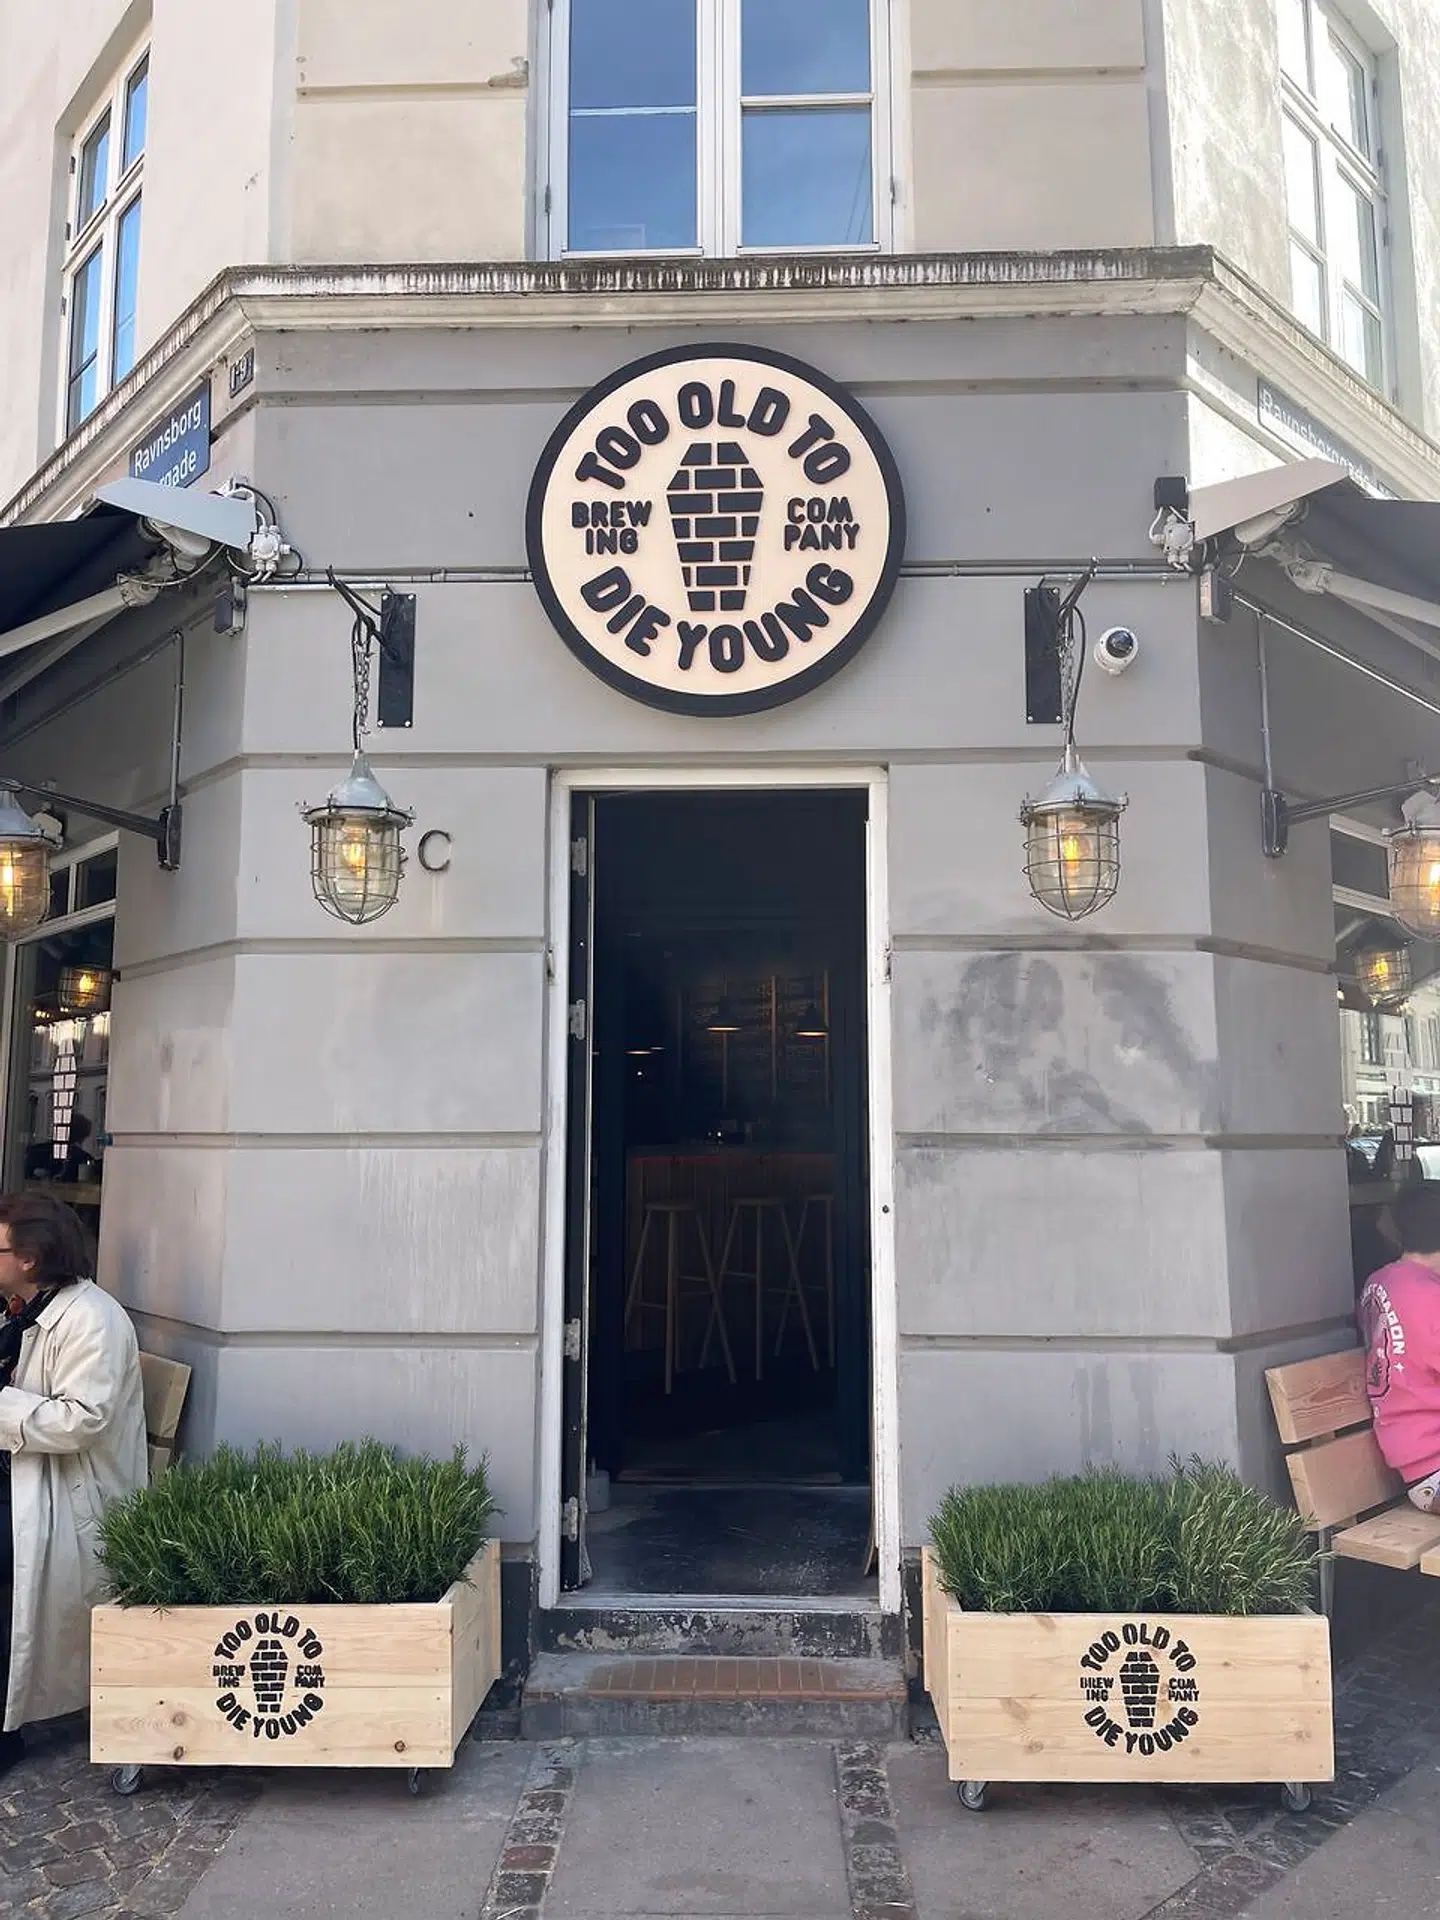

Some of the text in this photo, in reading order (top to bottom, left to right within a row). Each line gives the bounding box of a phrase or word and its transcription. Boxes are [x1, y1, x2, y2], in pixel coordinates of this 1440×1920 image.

[135, 400, 201, 476] Ravnsborg
[575, 379, 851, 490] TOO OLD TO
[571, 500, 651, 528] BREW
[788, 497, 852, 523] COM
[586, 528, 639, 554] ING
[784, 524, 860, 551] PANY
[580, 562, 854, 673] DIE YOUNG
[215, 1612, 323, 1660] TOO OLD TO
[1080, 1623, 1197, 1672] TOO OLD TO
[213, 1665, 245, 1676] BREW
[218, 1677, 240, 1688] ING
[297, 1665, 322, 1676] COM
[1080, 1677, 1114, 1689] BREW
[1169, 1678, 1197, 1689] COM
[1086, 1689, 1108, 1701] ING
[1168, 1690, 1200, 1701] PANY
[216, 1692, 324, 1739] DIE YOUNG
[1084, 1706, 1199, 1756] DIE YOUNG
